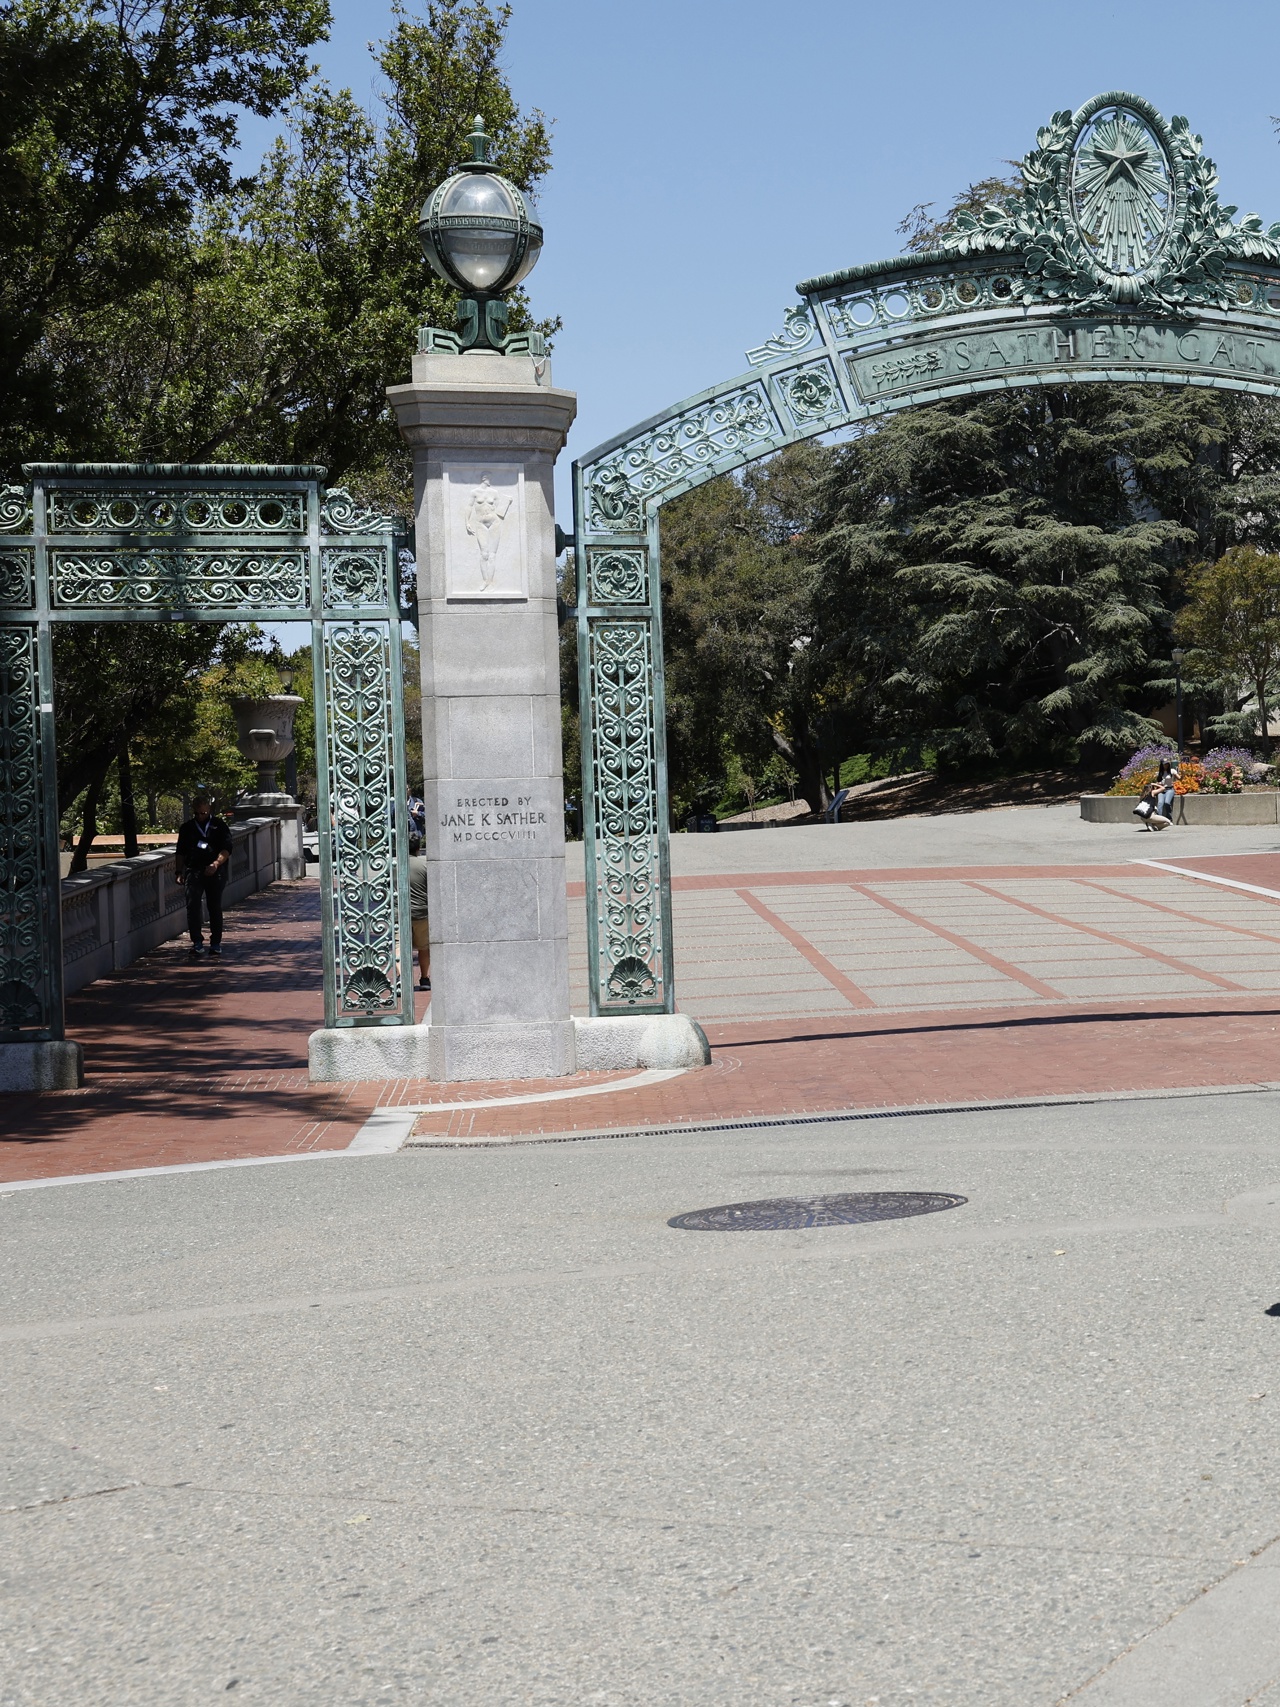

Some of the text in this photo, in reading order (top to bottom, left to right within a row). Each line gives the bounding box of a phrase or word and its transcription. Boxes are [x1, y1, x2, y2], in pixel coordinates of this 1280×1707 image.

[1124, 190, 1139, 202] LUX
[954, 328, 1146, 371] SATHER
[457, 796, 532, 808] ERECTED BY
[441, 812, 547, 827] JANE K SATHER
